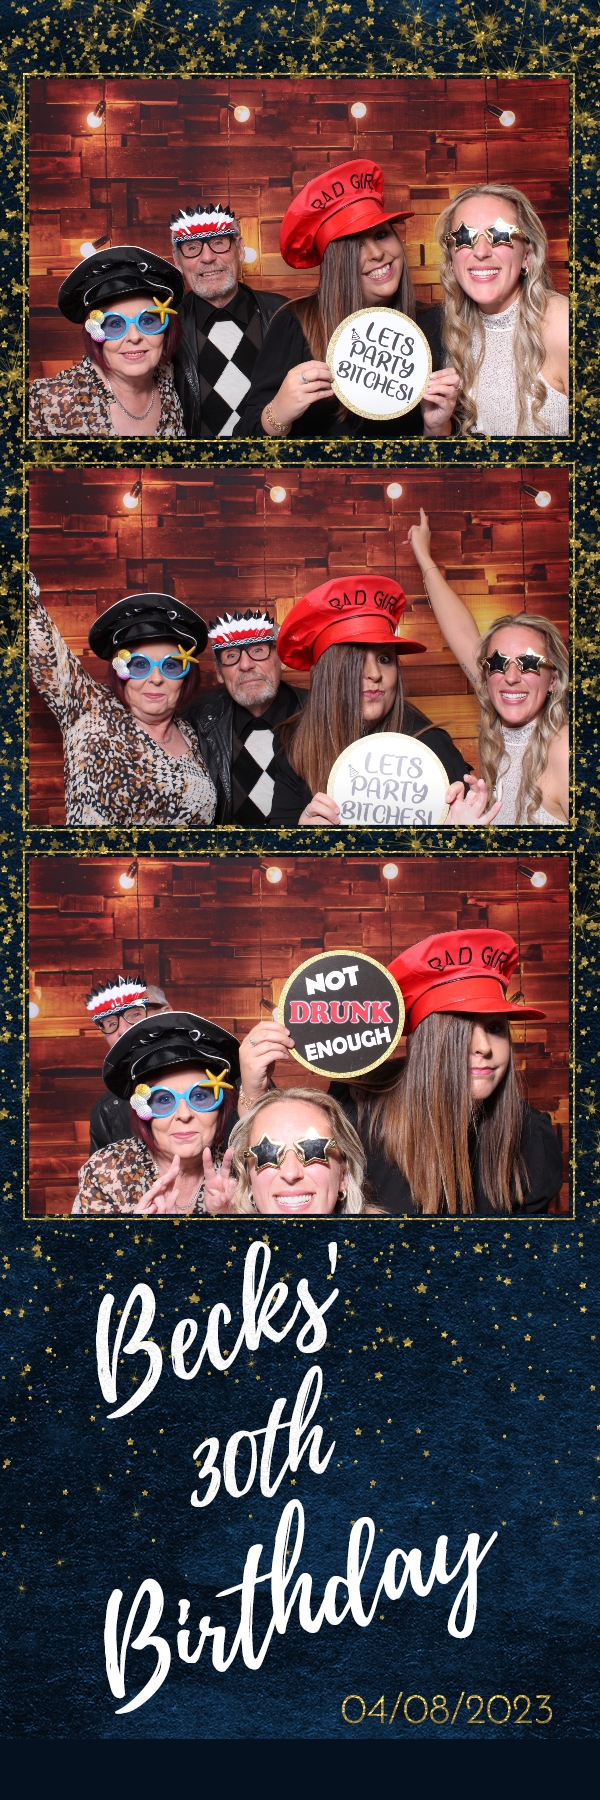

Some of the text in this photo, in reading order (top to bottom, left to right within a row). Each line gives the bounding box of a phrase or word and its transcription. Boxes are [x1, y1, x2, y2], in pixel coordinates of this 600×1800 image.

[310, 172, 375, 211] BAD GIR
[365, 321, 415, 356] LETS
[350, 340, 415, 379] PARTY
[336, 360, 414, 404] BITCHES!
[329, 589, 398, 615] BAD GIR
[364, 751, 424, 779] LETS
[350, 775, 429, 804] PARTY
[428, 945, 509, 974] BAD GIR
[305, 965, 360, 996] NOT
[288, 1000, 393, 1024] DRUNK
[304, 1026, 392, 1062] ENOUGH
